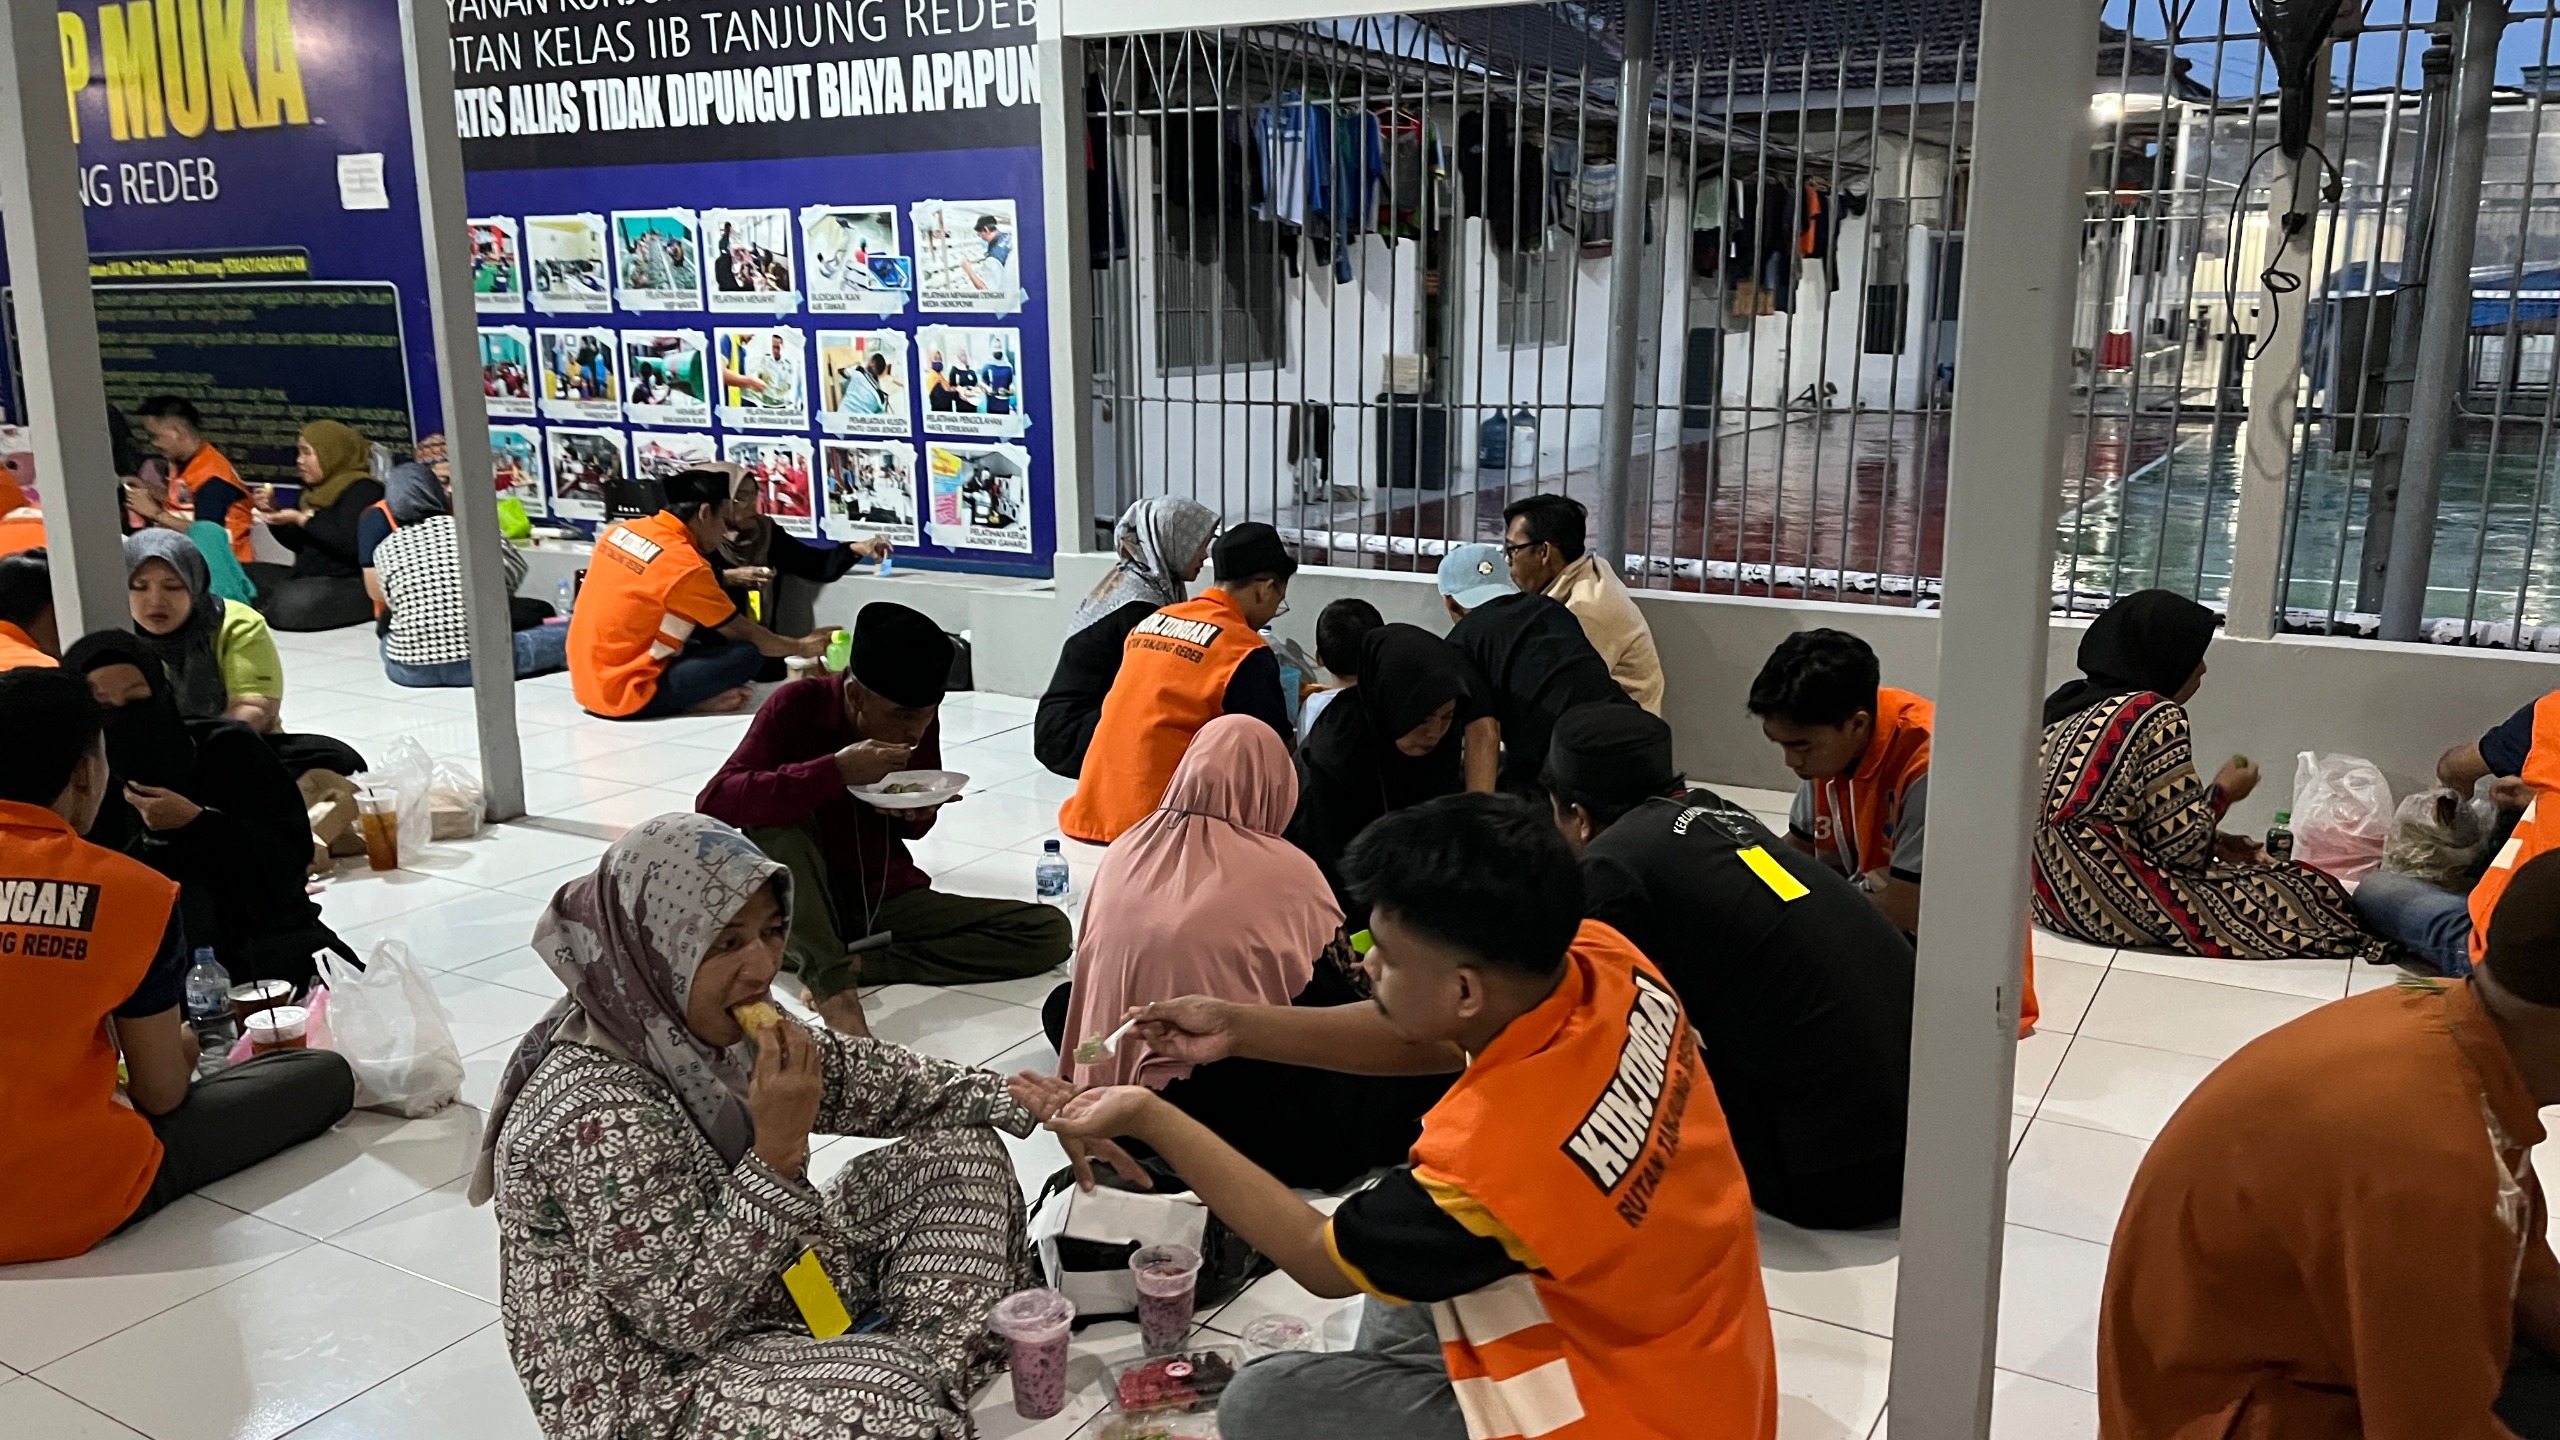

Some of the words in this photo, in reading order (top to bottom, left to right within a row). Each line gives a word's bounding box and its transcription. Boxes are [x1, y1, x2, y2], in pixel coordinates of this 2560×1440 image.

[534, 21, 636, 69] KELAS
[648, 16, 691, 60] IIB
[701, 0, 887, 55] TANJUNG
[905, 0, 1037, 38] REDEB
[99, 0, 310, 141] MUKA
[509, 80, 580, 136] ALIAS
[581, 75, 666, 132] TIDAK
[666, 64, 812, 128] DIPUNGUT
[817, 57, 908, 119] BIAYA
[912, 44, 1041, 112] APAPUN
[120, 157, 219, 205] REDEB
[966, 536, 998, 546] LAUNDRY
[970, 528, 1006, 538] PELATIHAN
[1006, 531, 1028, 541] KERJA
[1173, 644, 1204, 664] REDEB
[1815, 815, 1832, 840] 3
[0, 931, 17, 954] G
[22, 933, 88, 961] REDEB
[1568, 976, 1680, 1188] KUNJUNGAN
[1615, 1151, 1665, 1229] RUTAN
